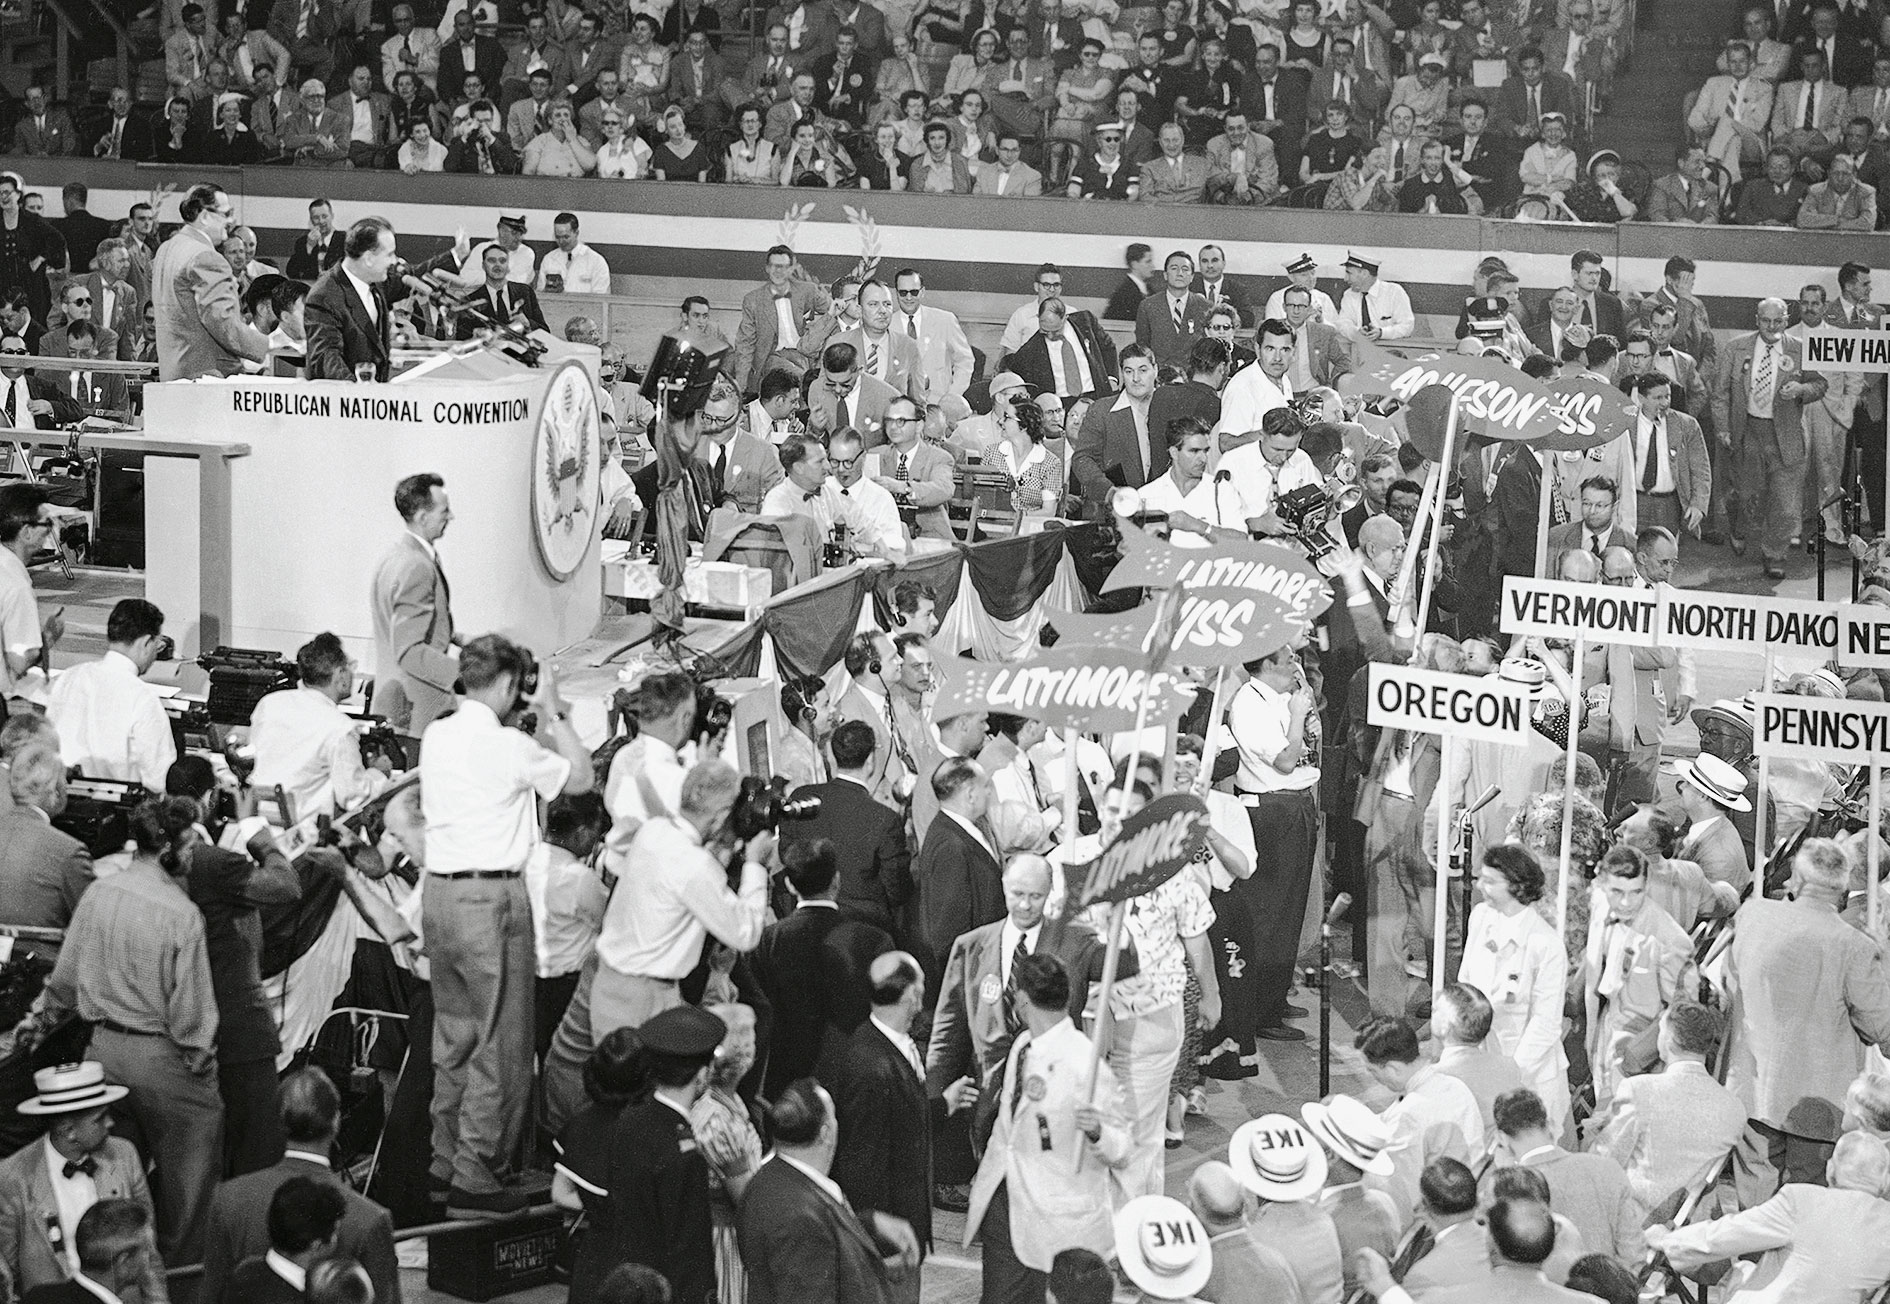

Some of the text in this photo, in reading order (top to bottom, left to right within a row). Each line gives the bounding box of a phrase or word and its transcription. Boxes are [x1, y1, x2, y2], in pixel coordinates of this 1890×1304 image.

[1808, 336, 1890, 364] NEW HA
[233, 390, 529, 425] REPUBLICAN NATIONAL CONVENTION
[1176, 557, 1320, 611] LATTIMORE
[1511, 589, 1657, 634] VERMONT
[1667, 602, 1838, 648] NORTH DAKO
[1848, 621, 1890, 655] NE
[986, 664, 1170, 713] LATTIMORE
[1377, 679, 1521, 732] OREGON
[1763, 705, 1890, 752] PENNSYL
[1256, 1128, 1305, 1150] IKE
[1146, 1219, 1197, 1248] IKE
